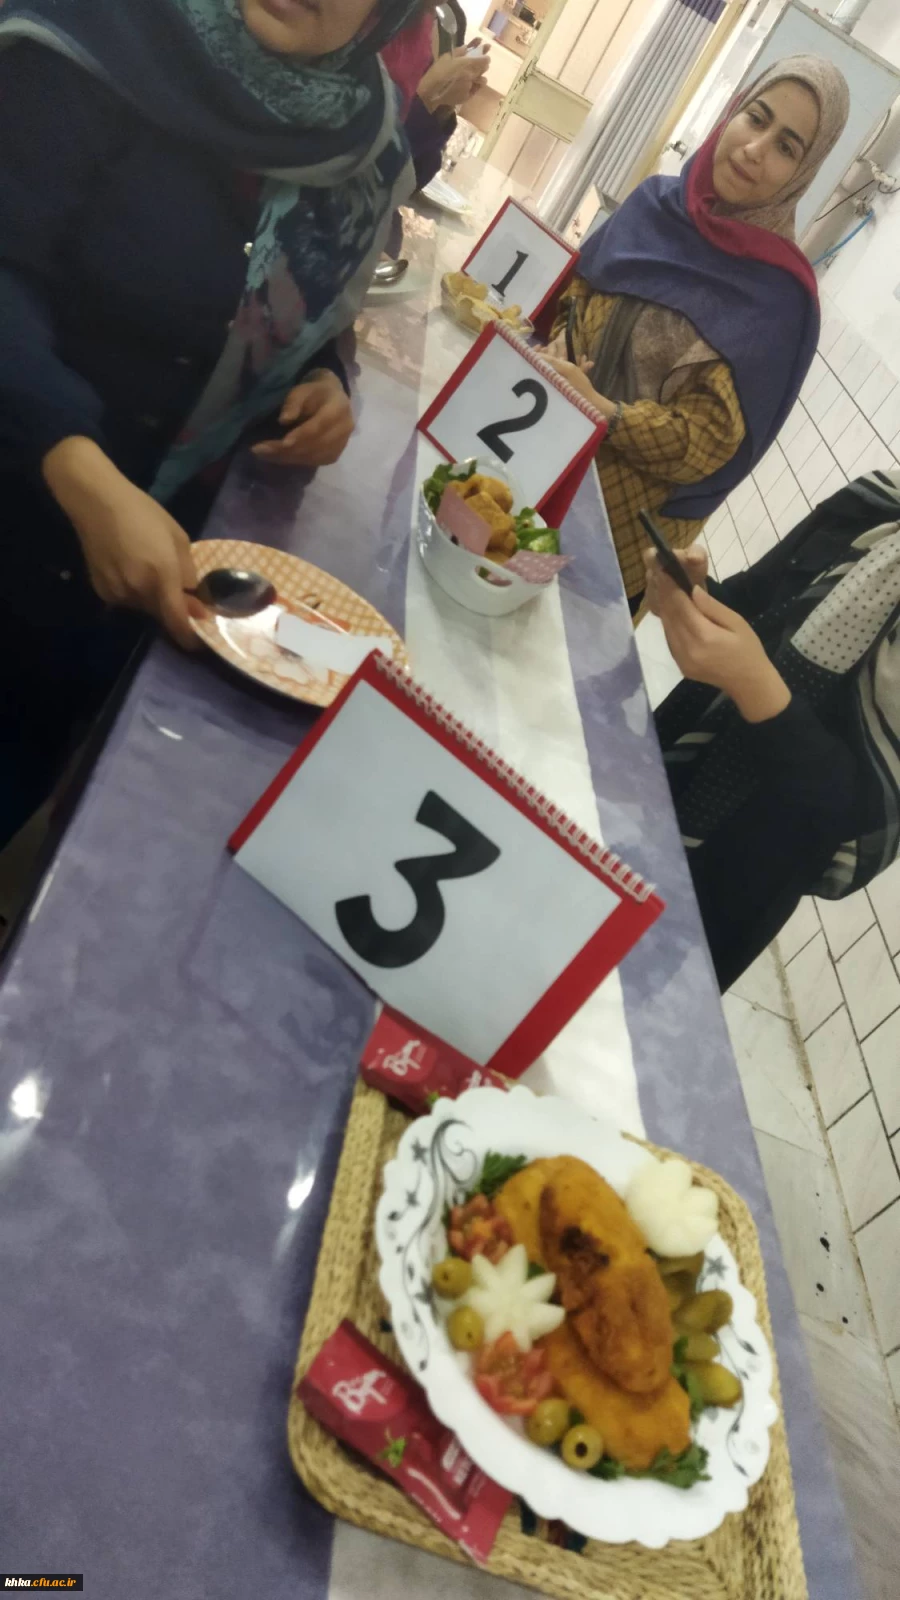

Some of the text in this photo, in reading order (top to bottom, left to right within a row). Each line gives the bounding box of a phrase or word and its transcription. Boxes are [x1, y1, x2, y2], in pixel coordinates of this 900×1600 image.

[491, 250, 529, 297] 1
[476, 378, 549, 464] 2
[335, 789, 502, 969] 3
